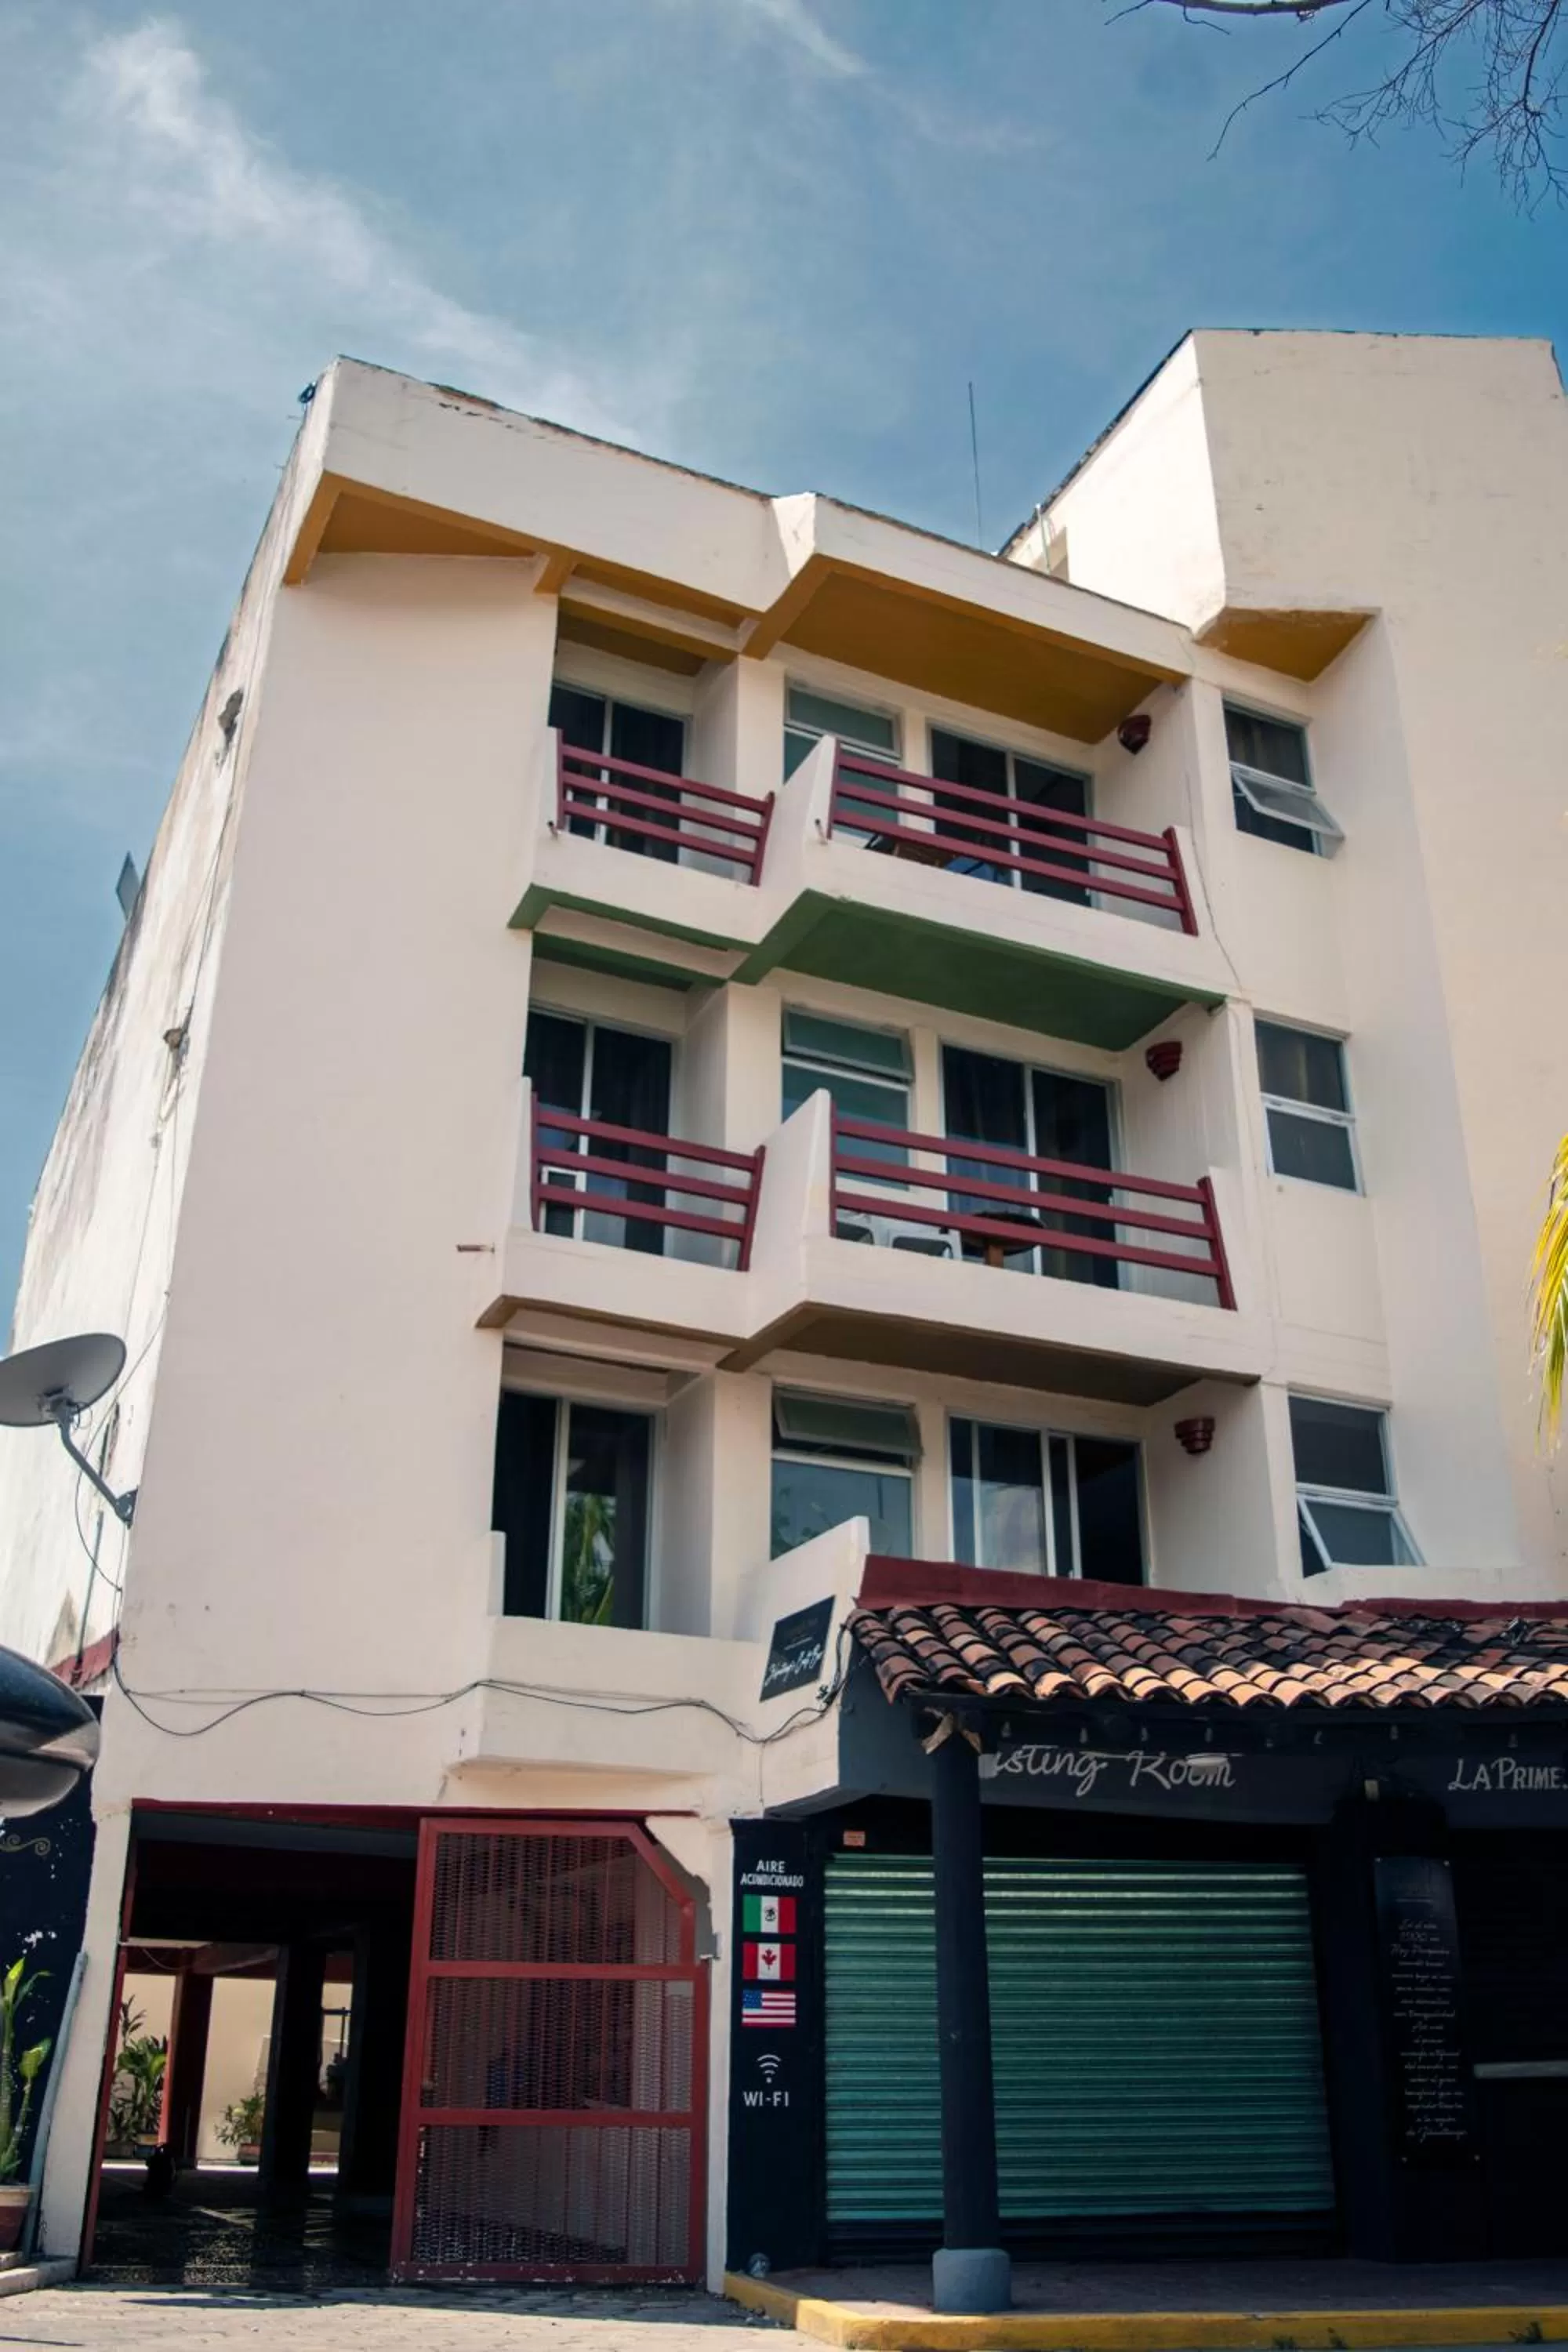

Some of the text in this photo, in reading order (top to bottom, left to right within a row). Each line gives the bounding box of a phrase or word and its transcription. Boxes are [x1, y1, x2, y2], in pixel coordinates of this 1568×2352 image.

[1448, 1757, 1568, 1791] LA PRIME
[756, 1859, 786, 1873] AIRE
[739, 1873, 804, 1887] ACONDICIONADO
[742, 2090, 789, 2107] WI-FI
